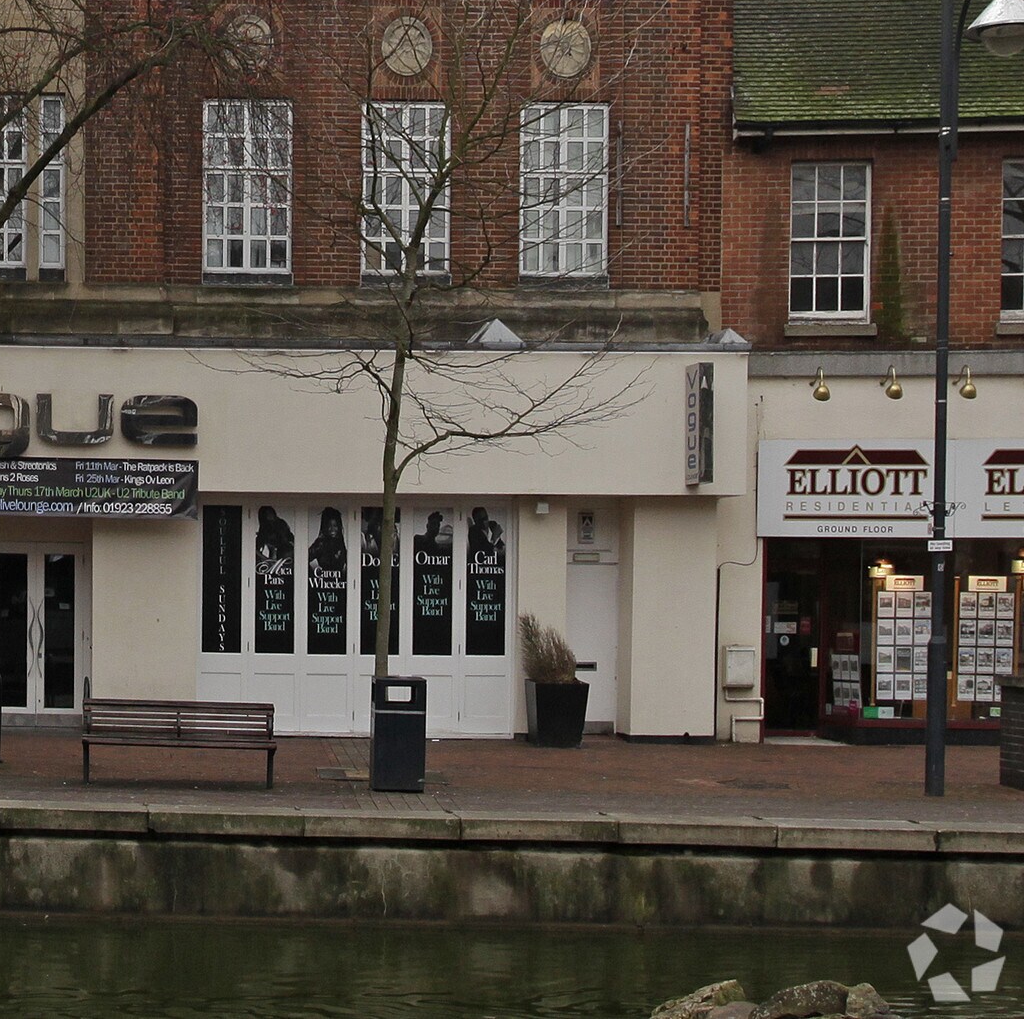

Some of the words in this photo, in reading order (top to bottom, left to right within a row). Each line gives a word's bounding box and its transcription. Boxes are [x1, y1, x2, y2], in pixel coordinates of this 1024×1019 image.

[122, 462, 136, 472] The
[175, 463, 194, 473] Back
[10, 473, 15, 482] 2
[16, 473, 39, 482] Roses
[124, 475, 144, 486] Kings
[156, 476, 175, 485] Leon
[786, 468, 928, 496] ELLIOTT
[8, 485, 32, 497] Thurs
[34, 486, 54, 497] 17th
[55, 487, 83, 497] March
[85, 487, 111, 498] U2UK
[116, 488, 130, 499] U2
[131, 488, 160, 499] Tribute
[161, 488, 185, 499] Band
[83, 502, 102, 513] Info:
[103, 503, 134, 514] 01923
[134, 503, 172, 514] 228855
[786, 501, 926, 512] RESIDENTIAL
[817, 525, 858, 533] GROUND
[863, 526, 894, 534] FLOOR
[415, 551, 450, 565] Omar
[475, 550, 498, 565] Carl
[314, 567, 341, 578] Caron
[468, 563, 504, 574] Thomas
[308, 578, 347, 589] Wheeler
[422, 574, 443, 585] With
[476, 579, 497, 590] With
[423, 585, 440, 595] Live
[477, 590, 494, 601] Live
[317, 592, 338, 602] With
[416, 595, 448, 608] Support
[266, 600, 283, 610] Live
[319, 603, 335, 613] Live
[470, 601, 501, 614] Support
[218, 585, 226, 651] SUNDAYS
[259, 611, 290, 624] Support
[312, 613, 343, 626] Support
